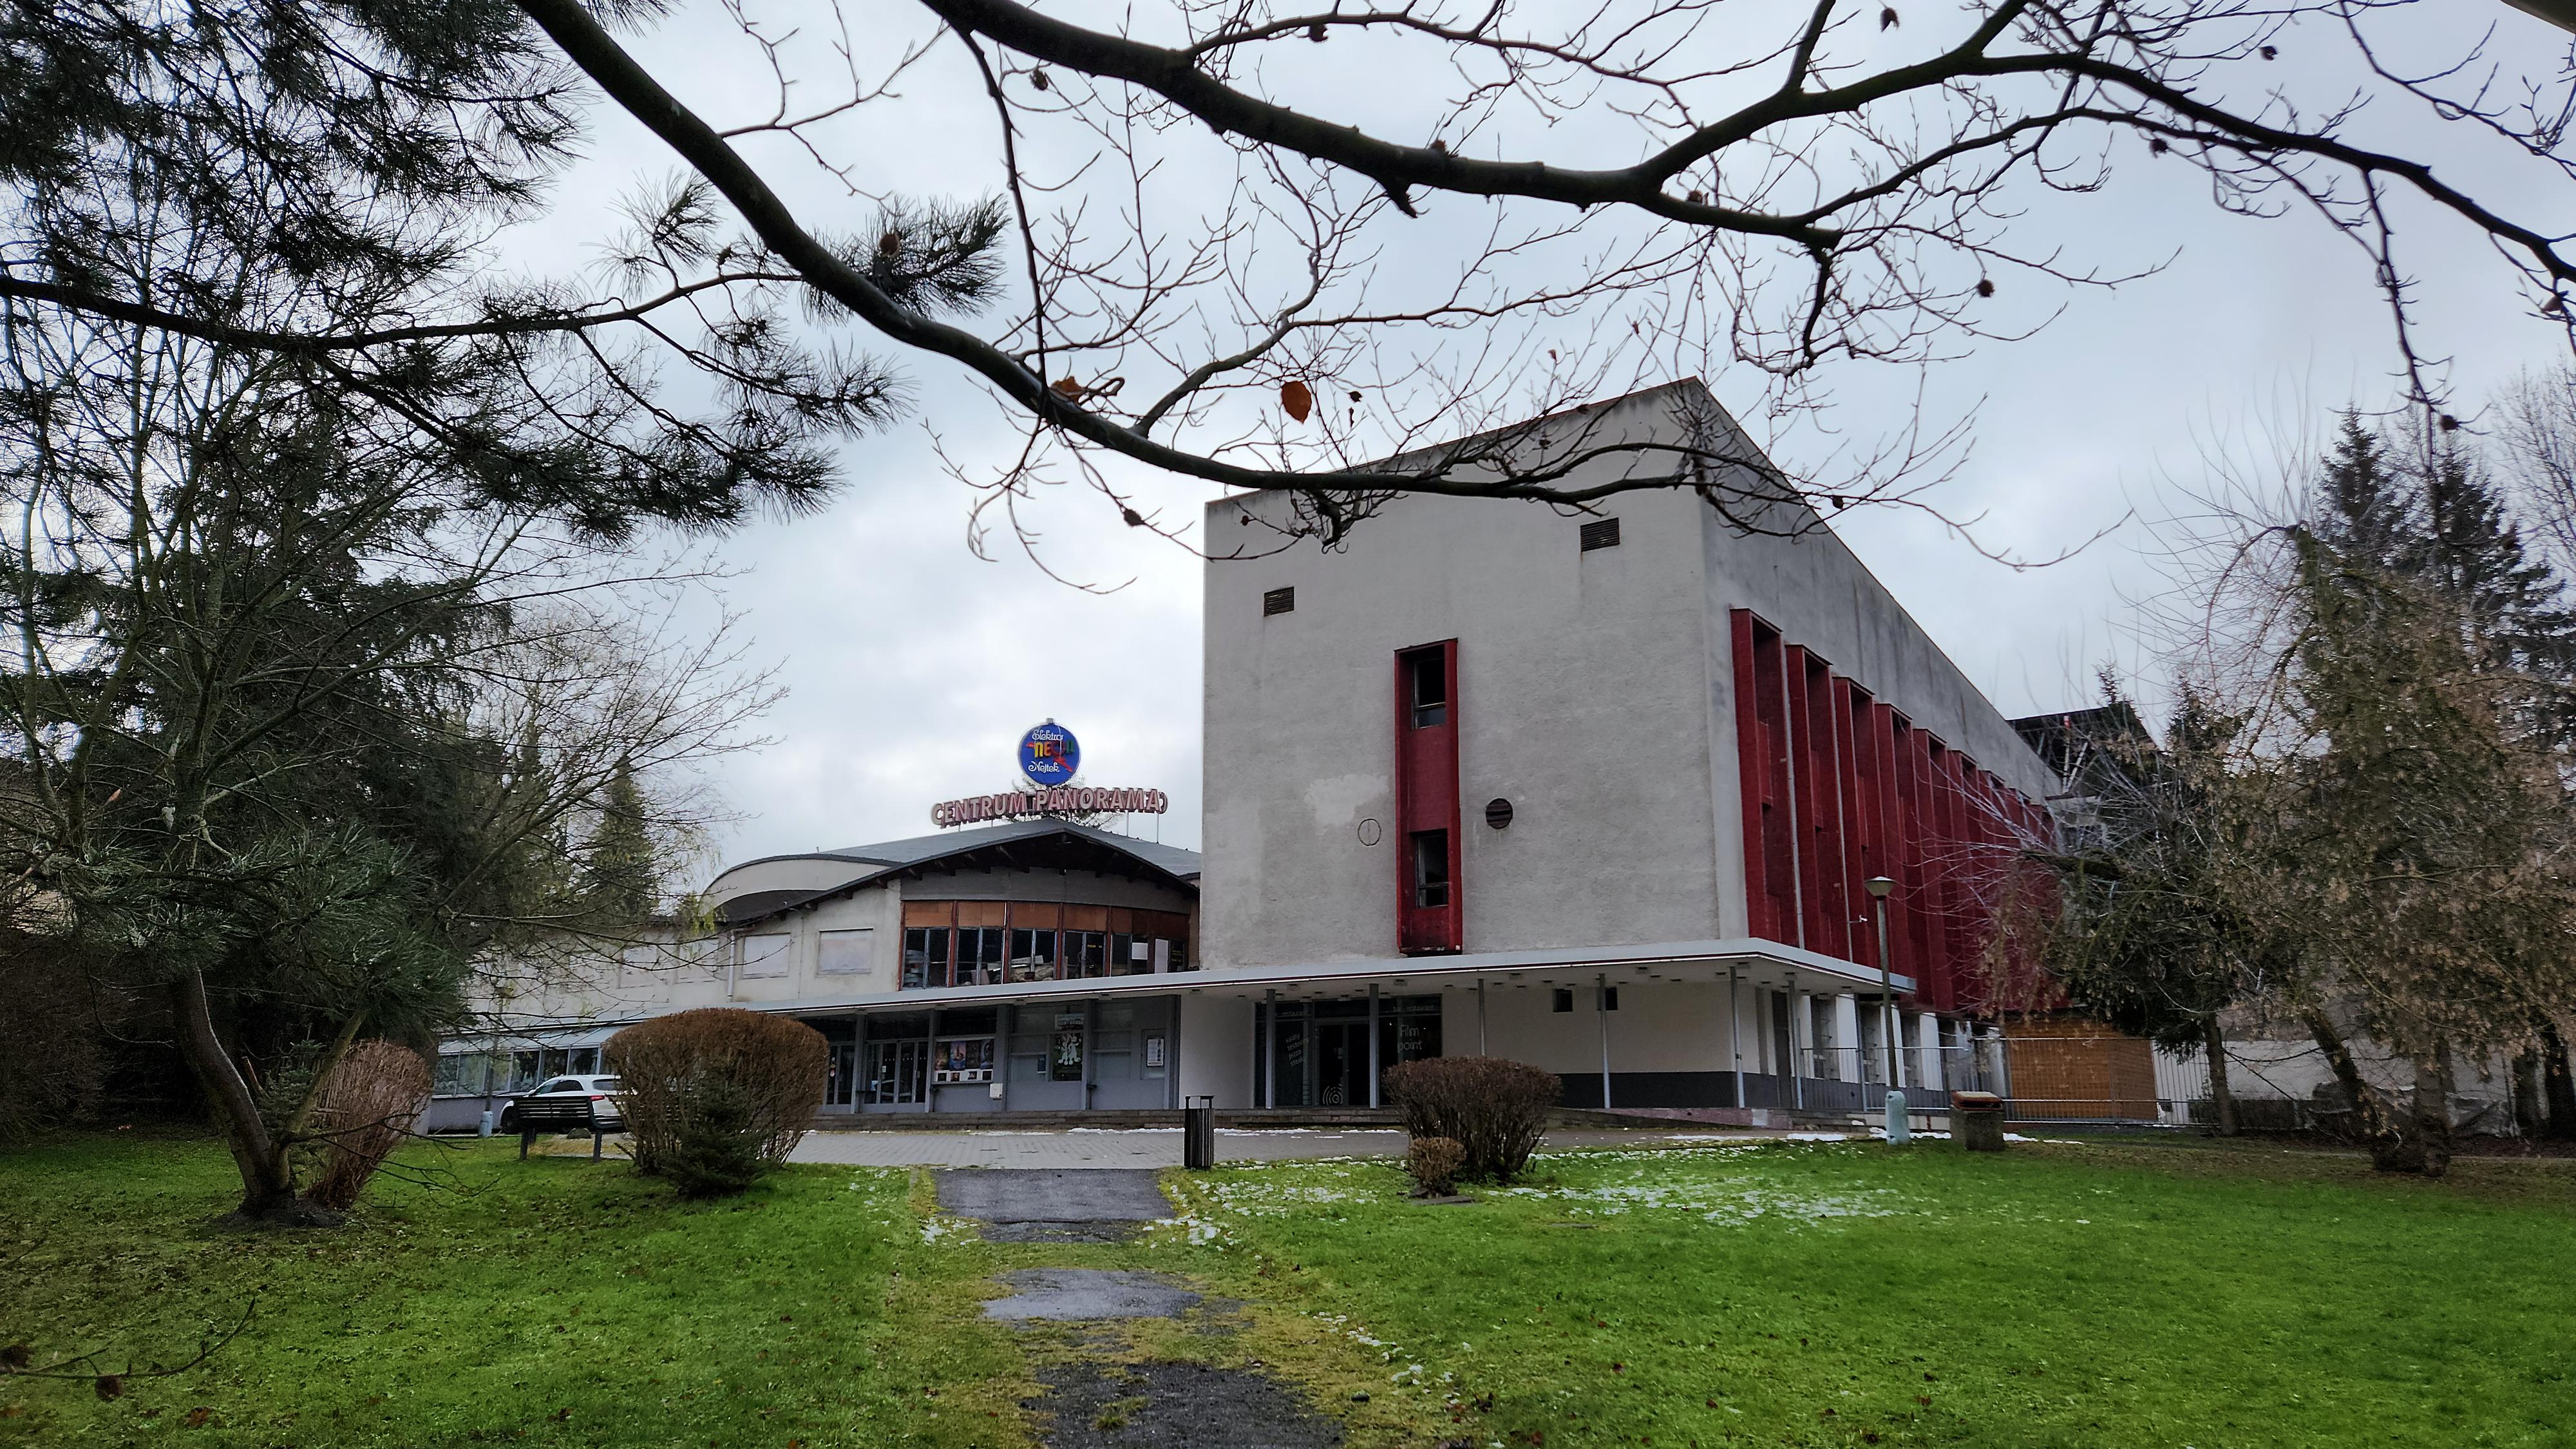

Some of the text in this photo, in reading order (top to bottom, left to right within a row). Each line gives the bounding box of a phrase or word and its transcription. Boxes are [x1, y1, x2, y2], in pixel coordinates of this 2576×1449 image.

[1032, 730, 1063, 741] Elektro
[932, 788, 1159, 827] CENTRUM PANORAMA
[1400, 1025, 1419, 1037] Film
[1397, 1038, 1423, 1054] point
